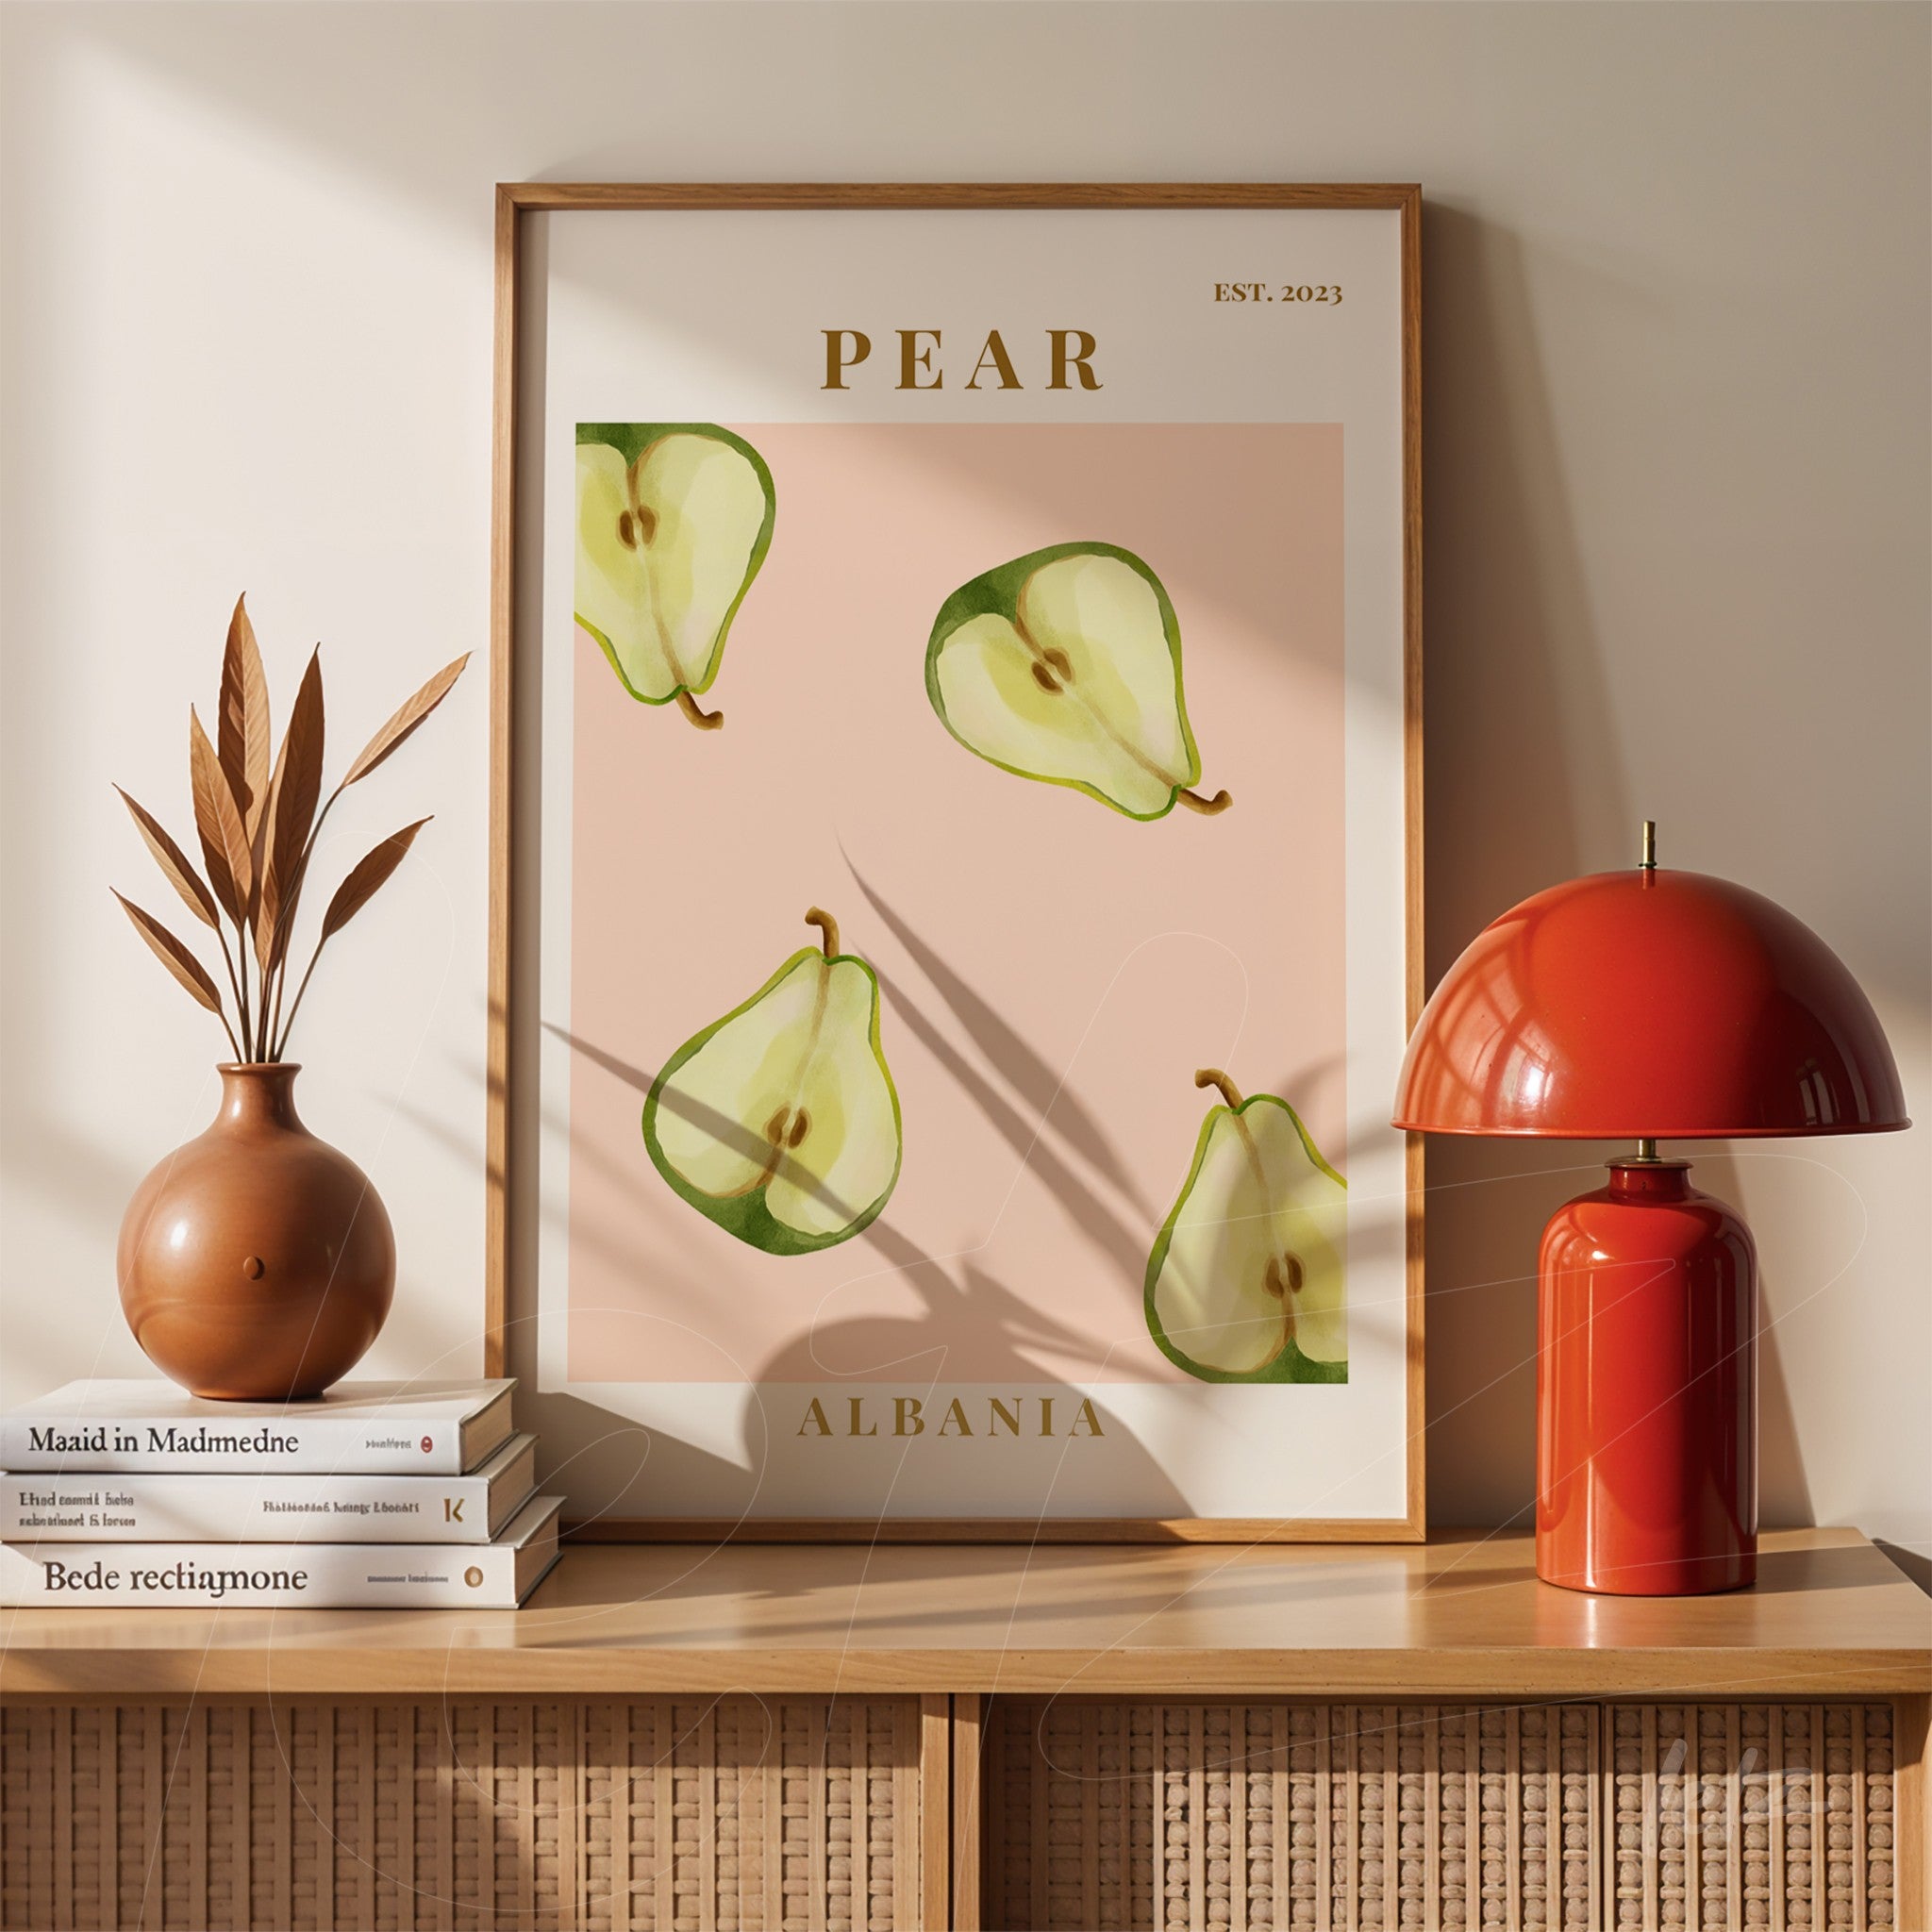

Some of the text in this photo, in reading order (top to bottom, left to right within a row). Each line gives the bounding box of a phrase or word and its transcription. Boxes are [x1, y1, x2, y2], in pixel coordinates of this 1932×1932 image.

[1213, 282, 1343, 307] EST. 2023
[820, 328, 1104, 391] PEAR
[795, 1396, 1106, 1438] ALBANIA
[113, 1426, 139, 1452] in
[43, 1561, 120, 1591] Bede
